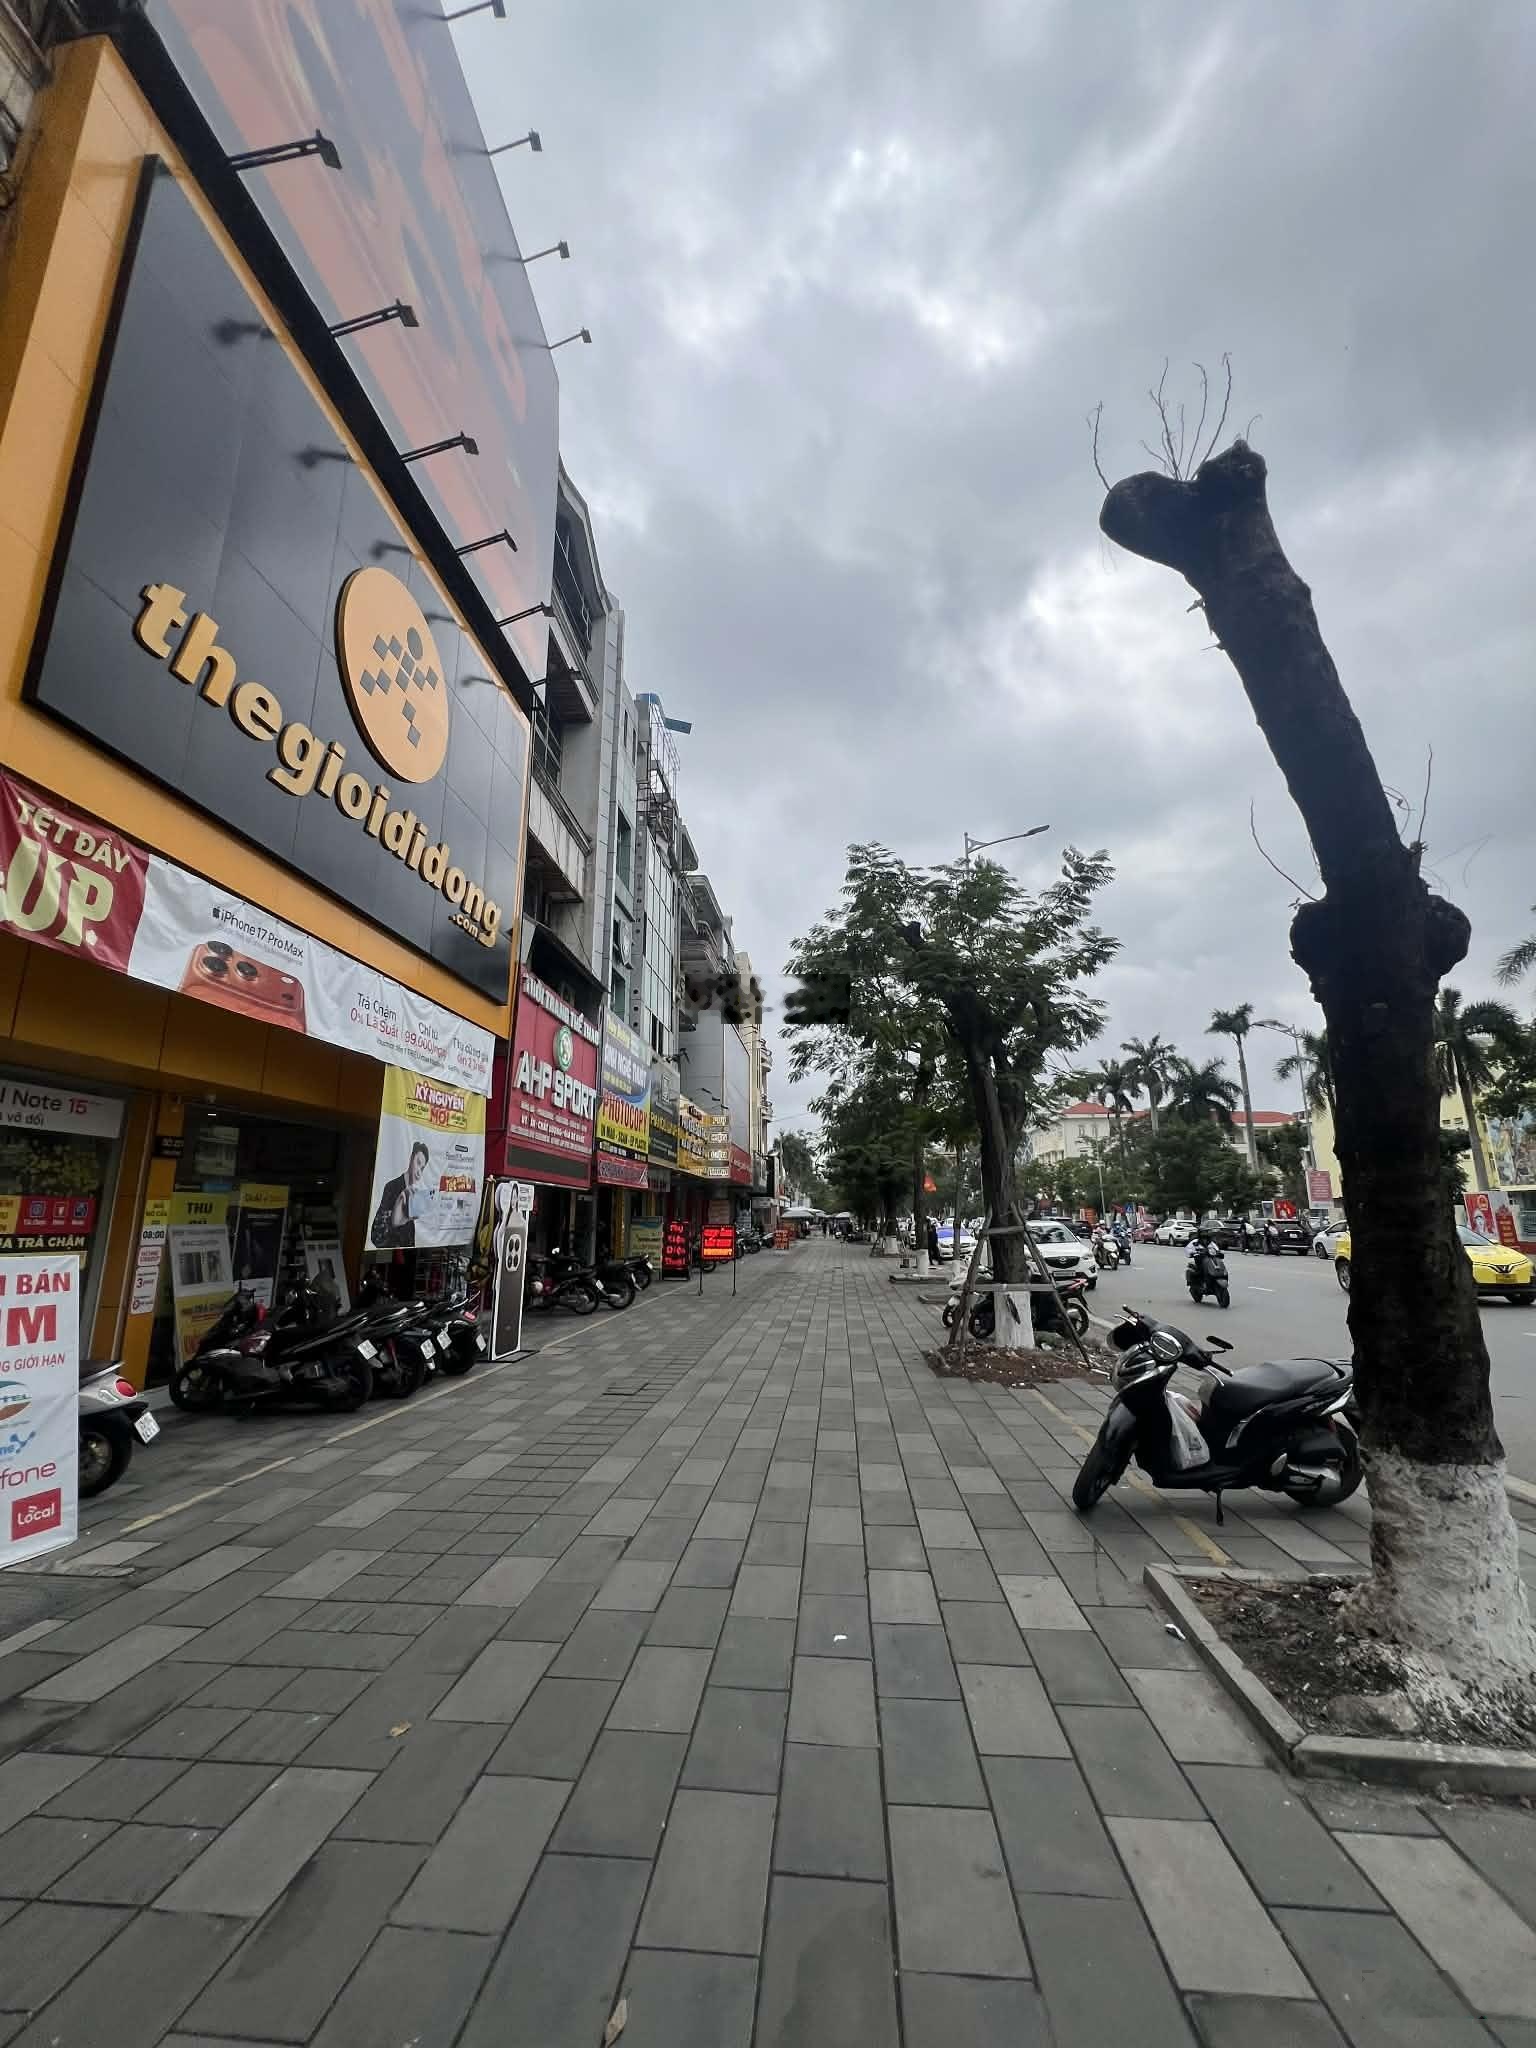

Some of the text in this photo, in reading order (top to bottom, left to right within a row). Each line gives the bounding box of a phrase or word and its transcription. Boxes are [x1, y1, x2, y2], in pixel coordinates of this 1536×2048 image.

[134, 583, 501, 948] thegioididong
[220, 908, 304, 959] iPhone 17 Pro Max
[452, 913, 479, 938] .com
[357, 992, 371, 1010] Trả
[513, 1050, 552, 1100] AHP
[552, 1069, 597, 1121] SPORT
[13, 1087, 62, 1112] Note
[68, 1097, 89, 1115] 15
[602, 1087, 648, 1134] PHOTOCOPY
[17, 1234, 45, 1249] TRẢ
[48, 1234, 86, 1250] CHẬM
[16, 1268, 71, 1296] BÁN
[0, 1304, 57, 1347] M
[14, 1354, 39, 1371] GIỚI
[41, 1353, 66, 1368] HẠN
[0, 1461, 57, 1490] fone
[17, 1503, 56, 1526] Local
